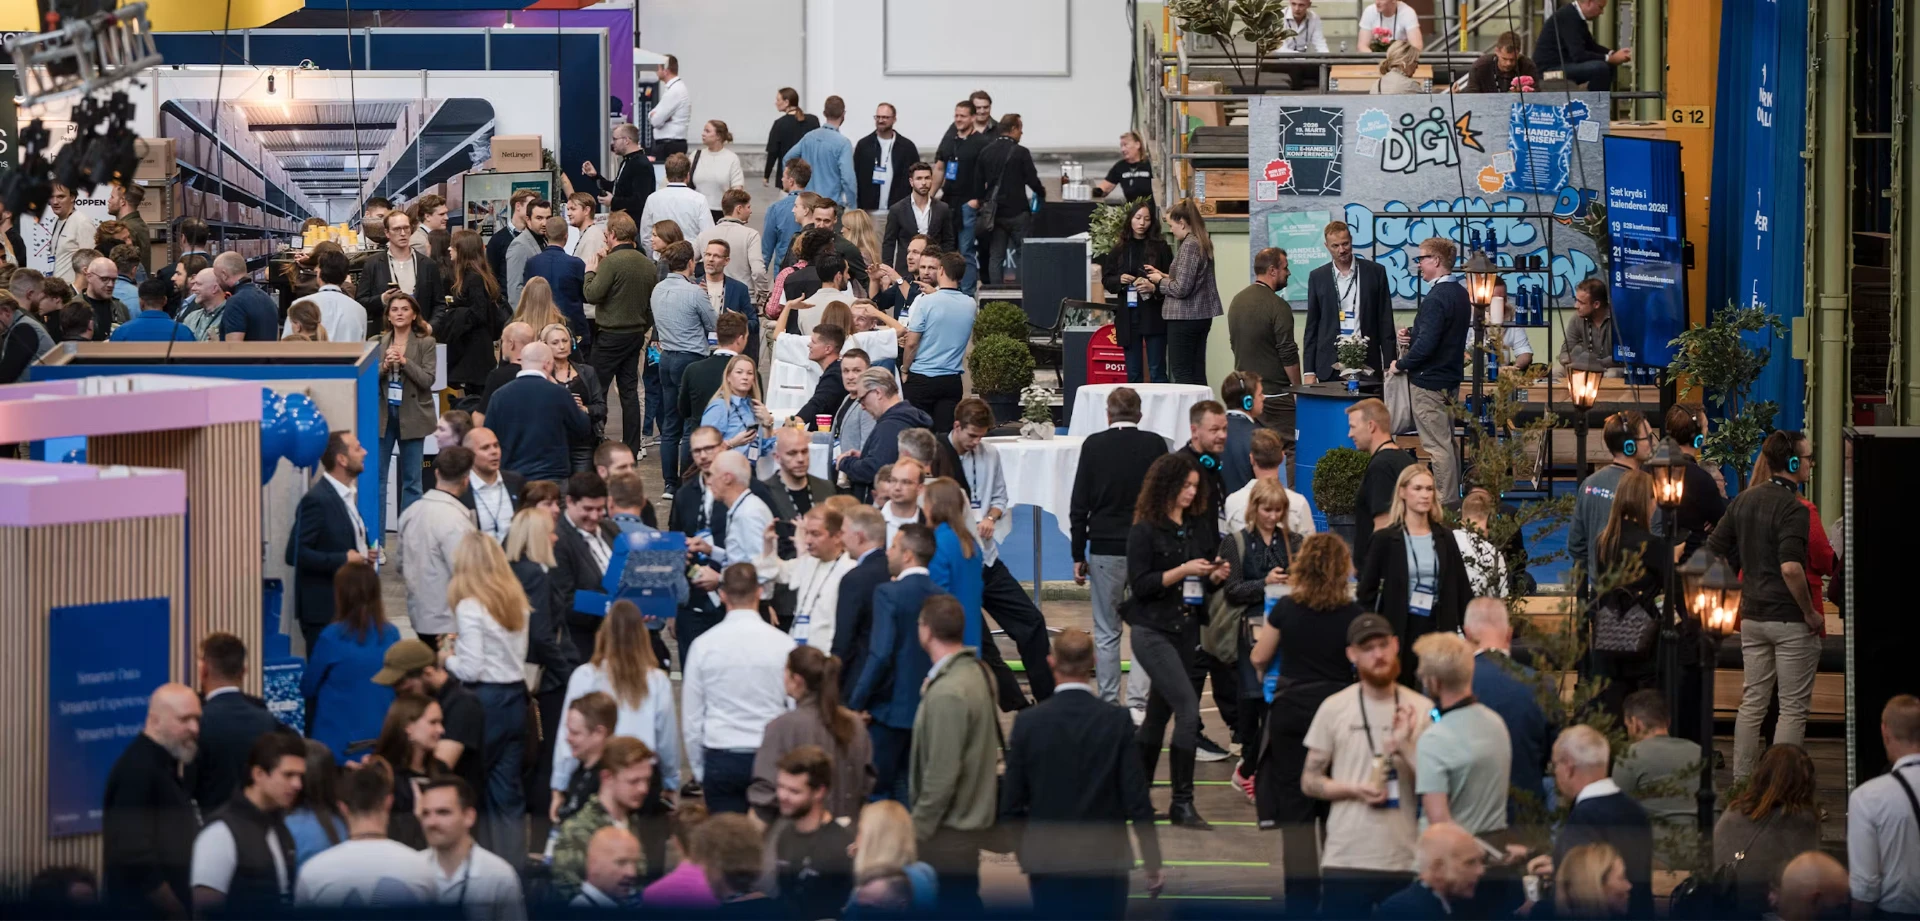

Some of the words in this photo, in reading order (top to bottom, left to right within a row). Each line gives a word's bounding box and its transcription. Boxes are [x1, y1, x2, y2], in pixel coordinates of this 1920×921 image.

[1672, 109, 1683, 123] G
[1688, 110, 1704, 123] 12
[1515, 127, 1566, 138] E-HANDELS
[1610, 186, 1623, 197] Sæt
[1624, 188, 1643, 200] kryds
[1643, 189, 1647, 199] i
[1611, 198, 1648, 211] kalenderen
[1648, 202, 1668, 213] 2026!
[1612, 221, 1621, 231] 19
[1612, 246, 1622, 257] 21
[1623, 247, 1660, 258] E-handelsprisen
[1615, 271, 1622, 282] 8
[1624, 272, 1675, 285] E-handelskonferencen
[1105, 363, 1126, 371] POST
